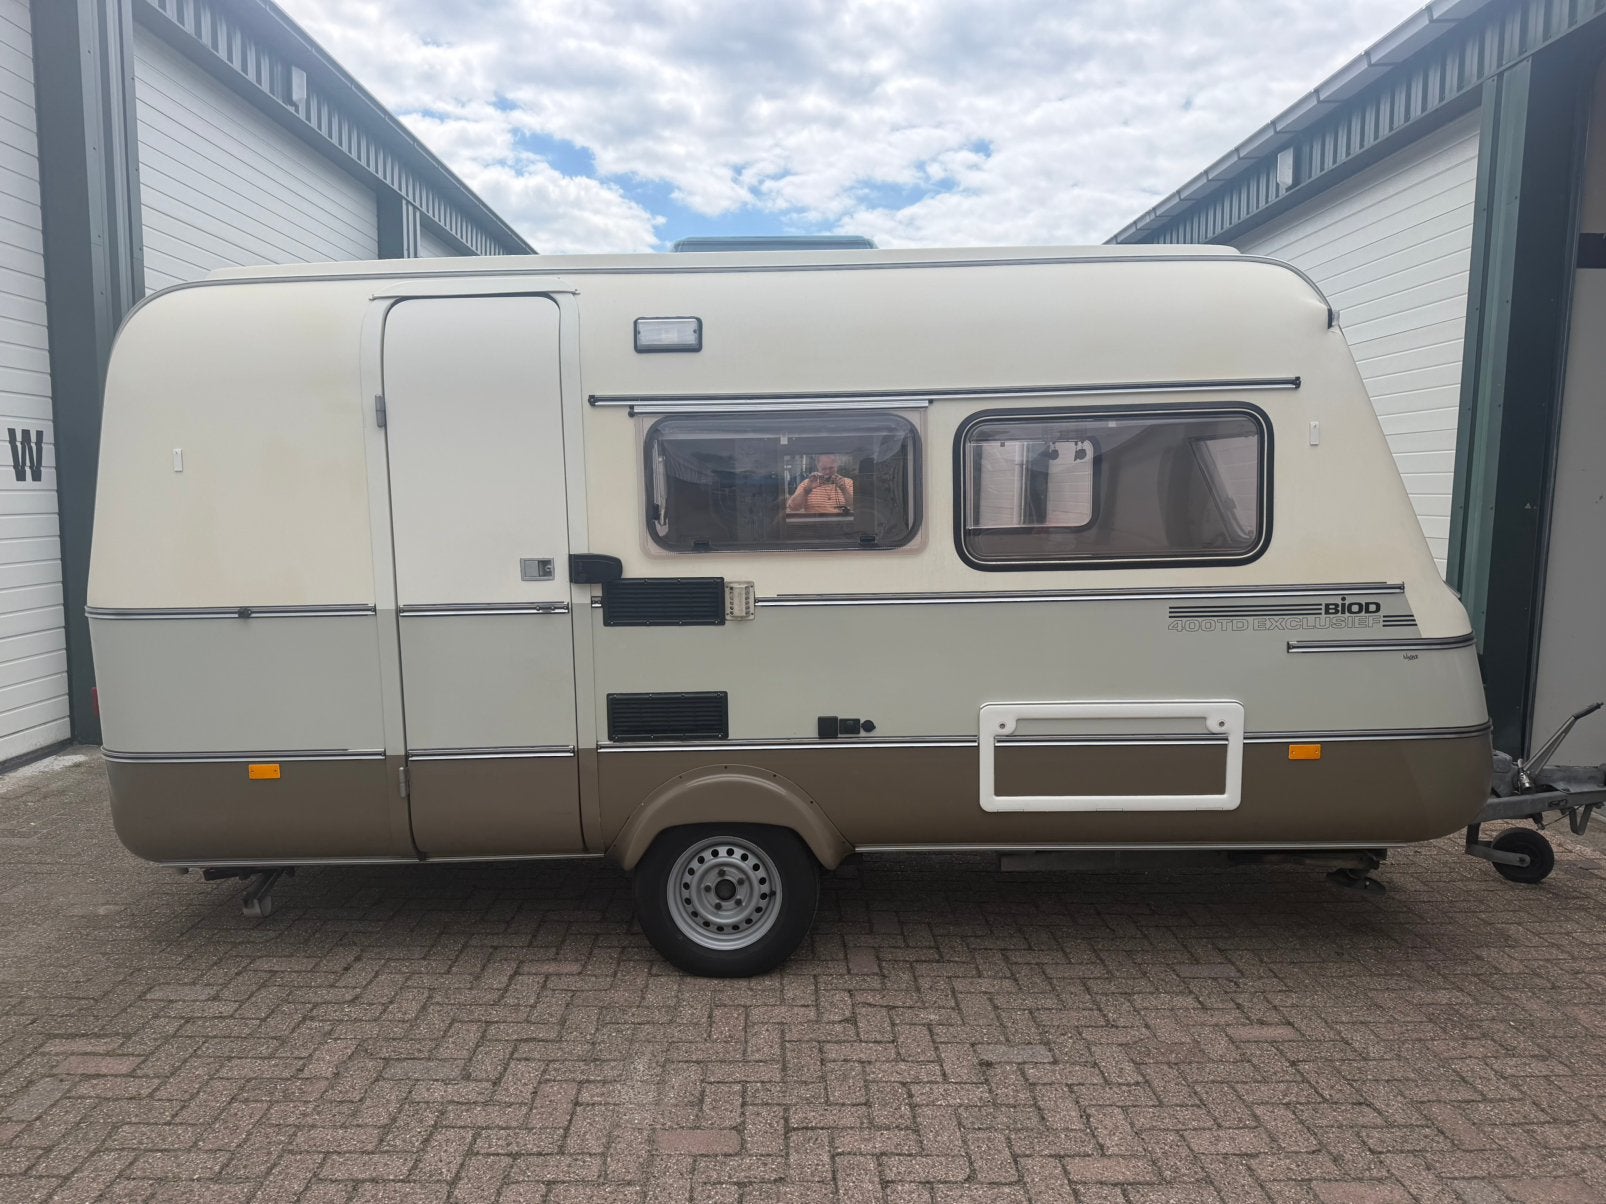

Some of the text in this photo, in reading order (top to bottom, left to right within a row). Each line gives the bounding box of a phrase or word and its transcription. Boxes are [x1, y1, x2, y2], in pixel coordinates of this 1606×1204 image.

[7, 427, 44, 482] W
[1168, 614, 1381, 632] 400TD EXCLUSIEF
